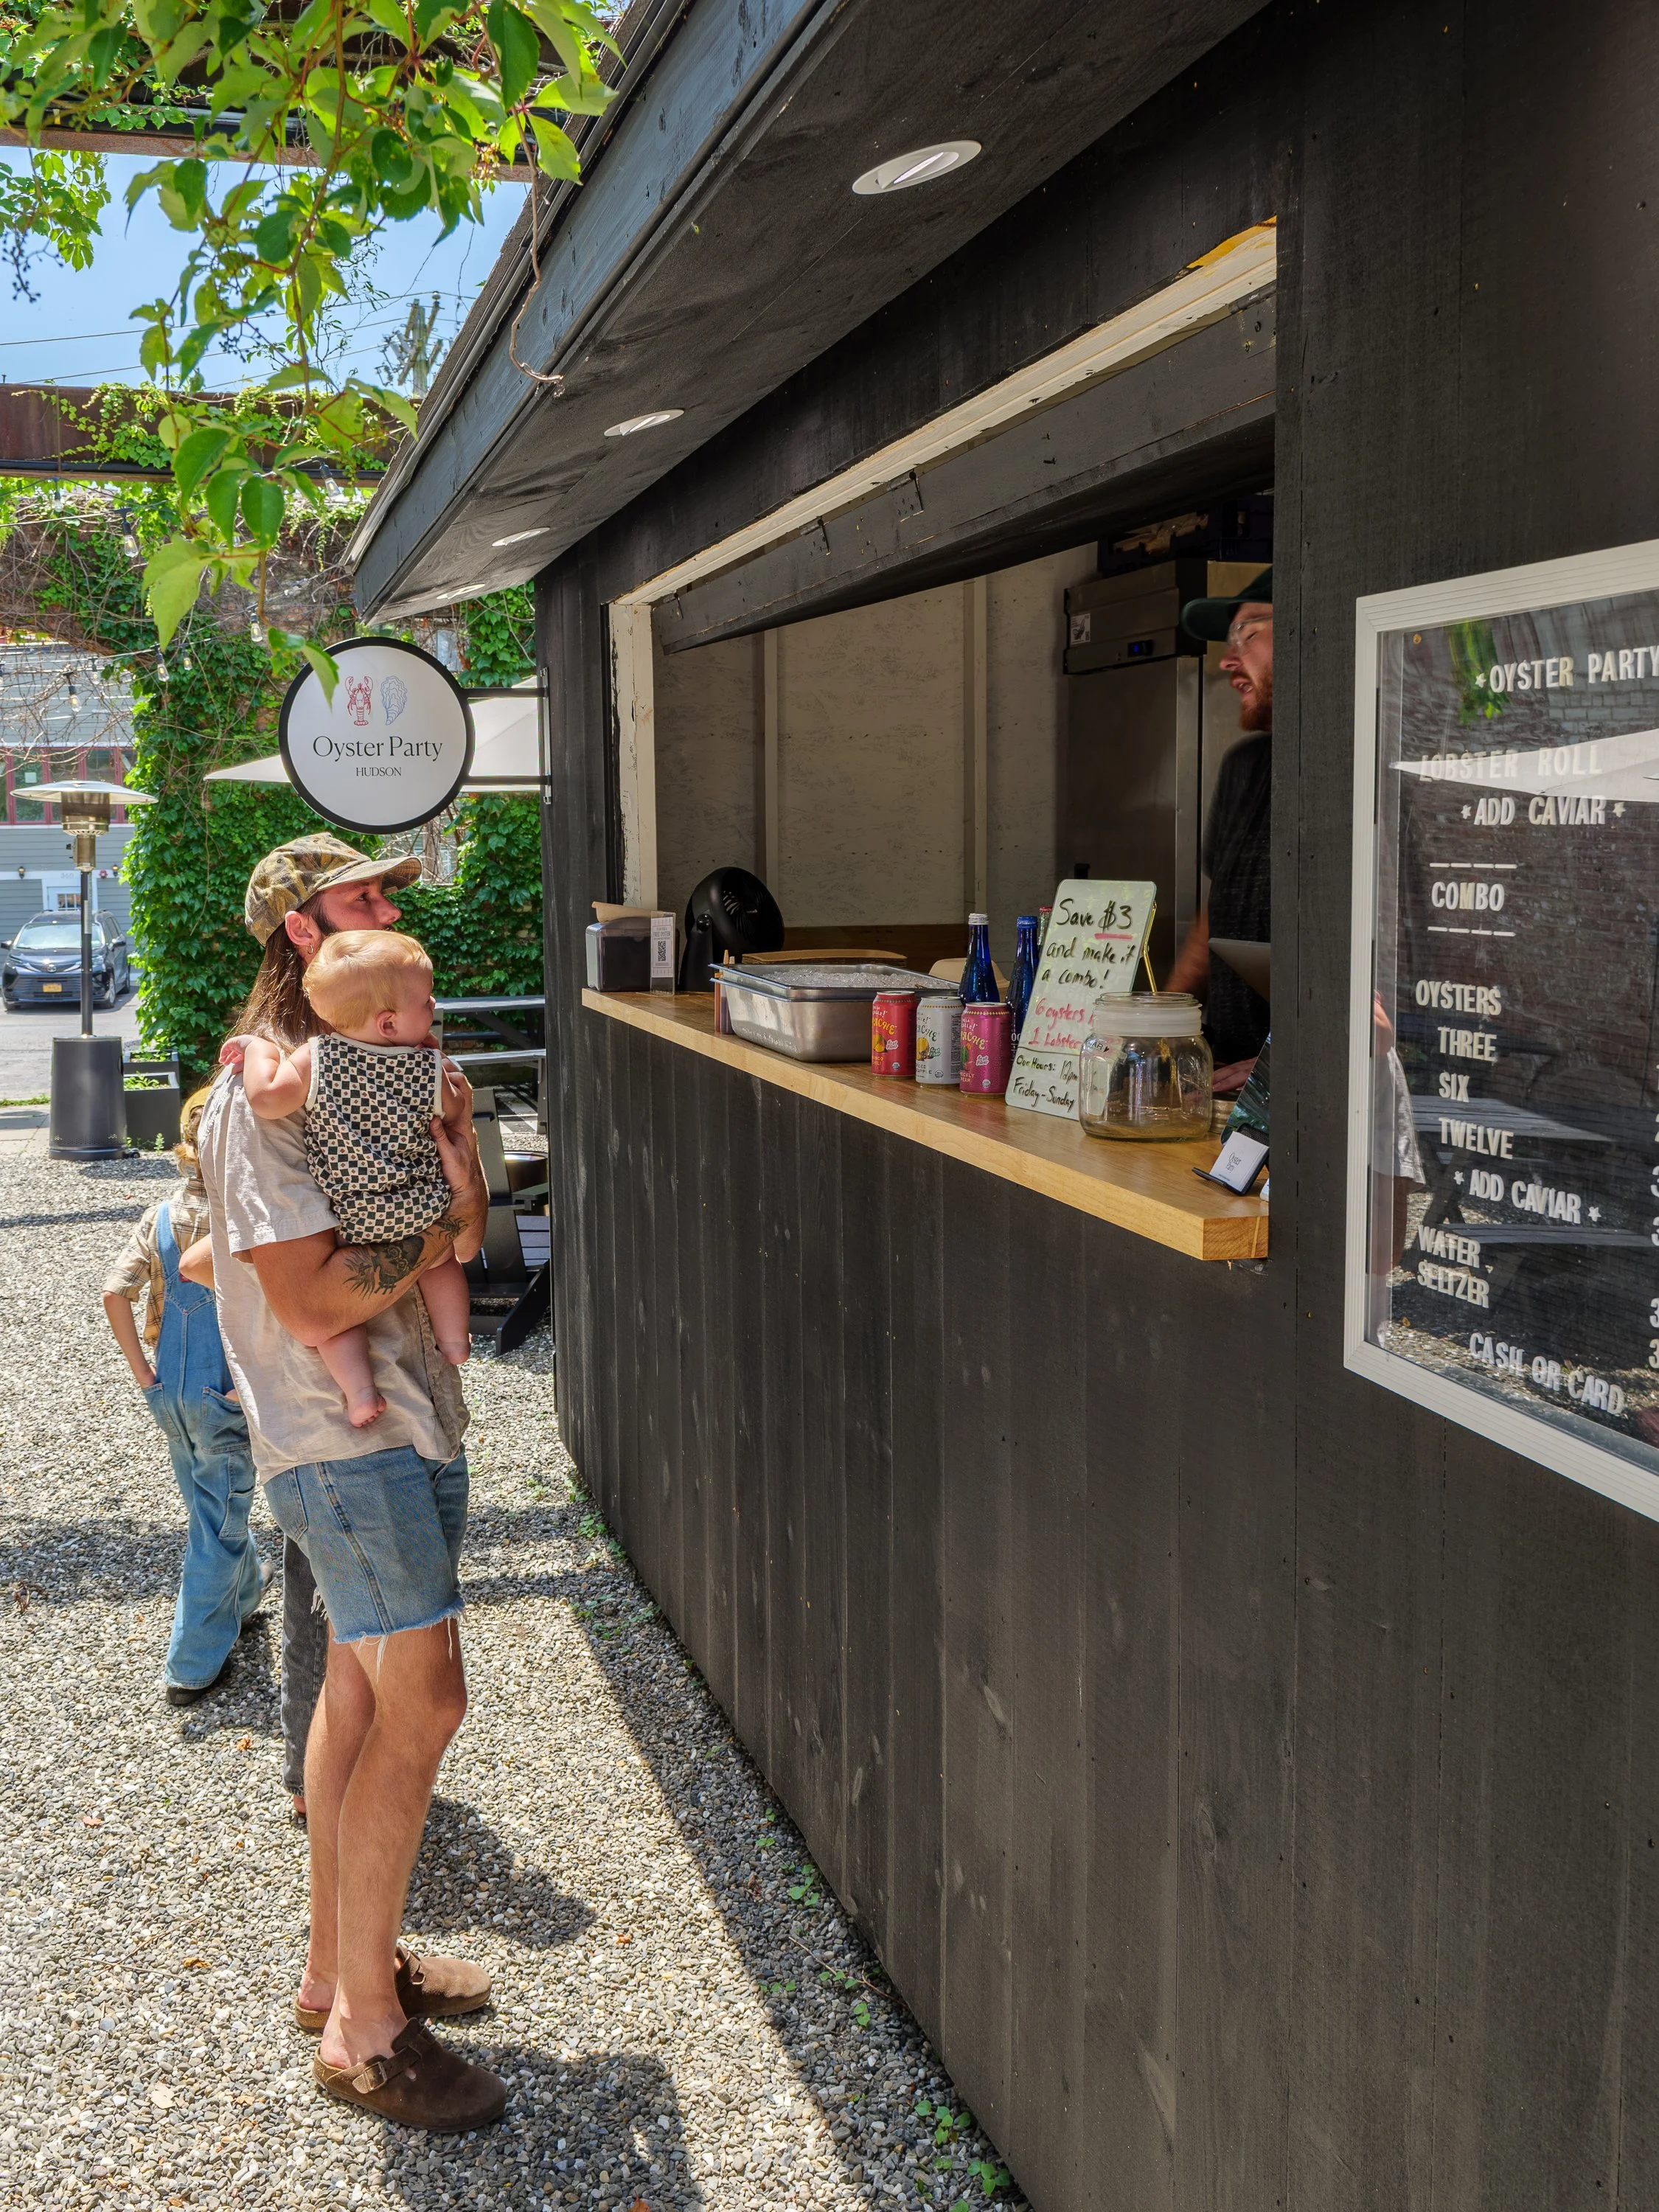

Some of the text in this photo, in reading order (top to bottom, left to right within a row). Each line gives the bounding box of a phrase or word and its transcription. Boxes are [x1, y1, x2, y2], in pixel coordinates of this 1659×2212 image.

[1489, 646, 1659, 693] OYSTER PARTY
[313, 735, 443, 762] Oyster Party
[1419, 745, 1603, 782] LOBSTER ROLL
[355, 767, 402, 776] HUDSON
[1473, 794, 1607, 826] ADD CAVIAR
[1431, 881, 1505, 911] COMBO
[1056, 897, 1133, 933] Save $3
[1046, 936, 1136, 965] and make it
[1041, 968, 1110, 990] a combo!
[1416, 979, 1501, 1016] OYSTERS
[1438, 1026, 1498, 1062] THREE
[1016, 1054, 1031, 1066] Our
[1031, 1057, 1056, 1071] Hours:
[1439, 1071, 1470, 1103] SIX
[1438, 1117, 1514, 1160] TWELVE
[1470, 1169, 1504, 1203] ADD
[1512, 1181, 1582, 1224] CAVIAR
[1418, 1224, 1481, 1268] WATER
[1417, 1259, 1489, 1309] SELTZER
[1469, 1332, 1625, 1416] CASH OR CARD
